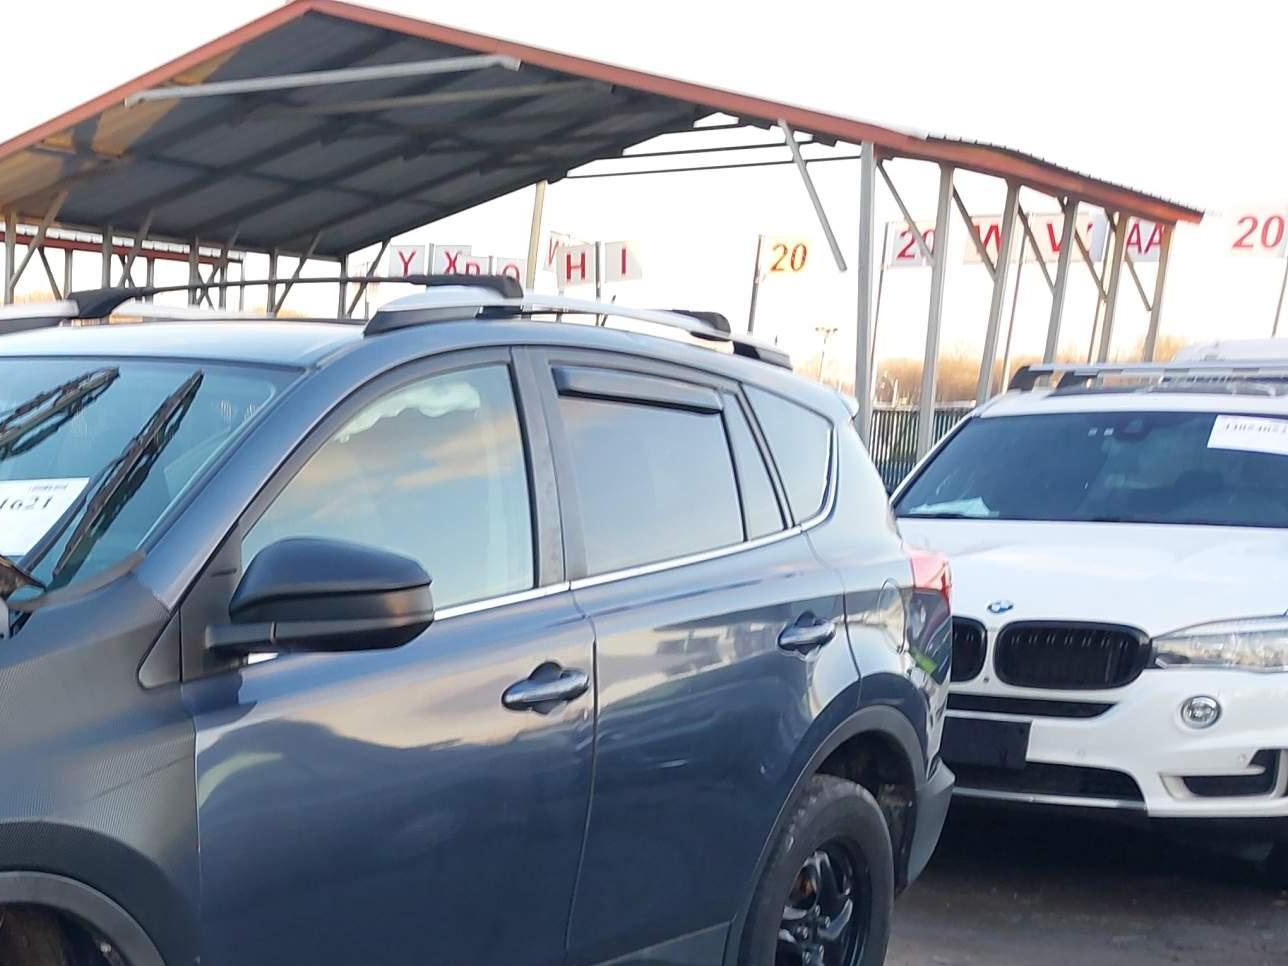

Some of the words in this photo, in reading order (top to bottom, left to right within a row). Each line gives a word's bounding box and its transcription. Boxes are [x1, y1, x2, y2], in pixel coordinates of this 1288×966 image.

[1232, 215, 1285, 249] 20
[398, 251, 417, 277] Y
[444, 251, 464, 276] X
[567, 251, 586, 282] H
[770, 242, 808, 272] 20
